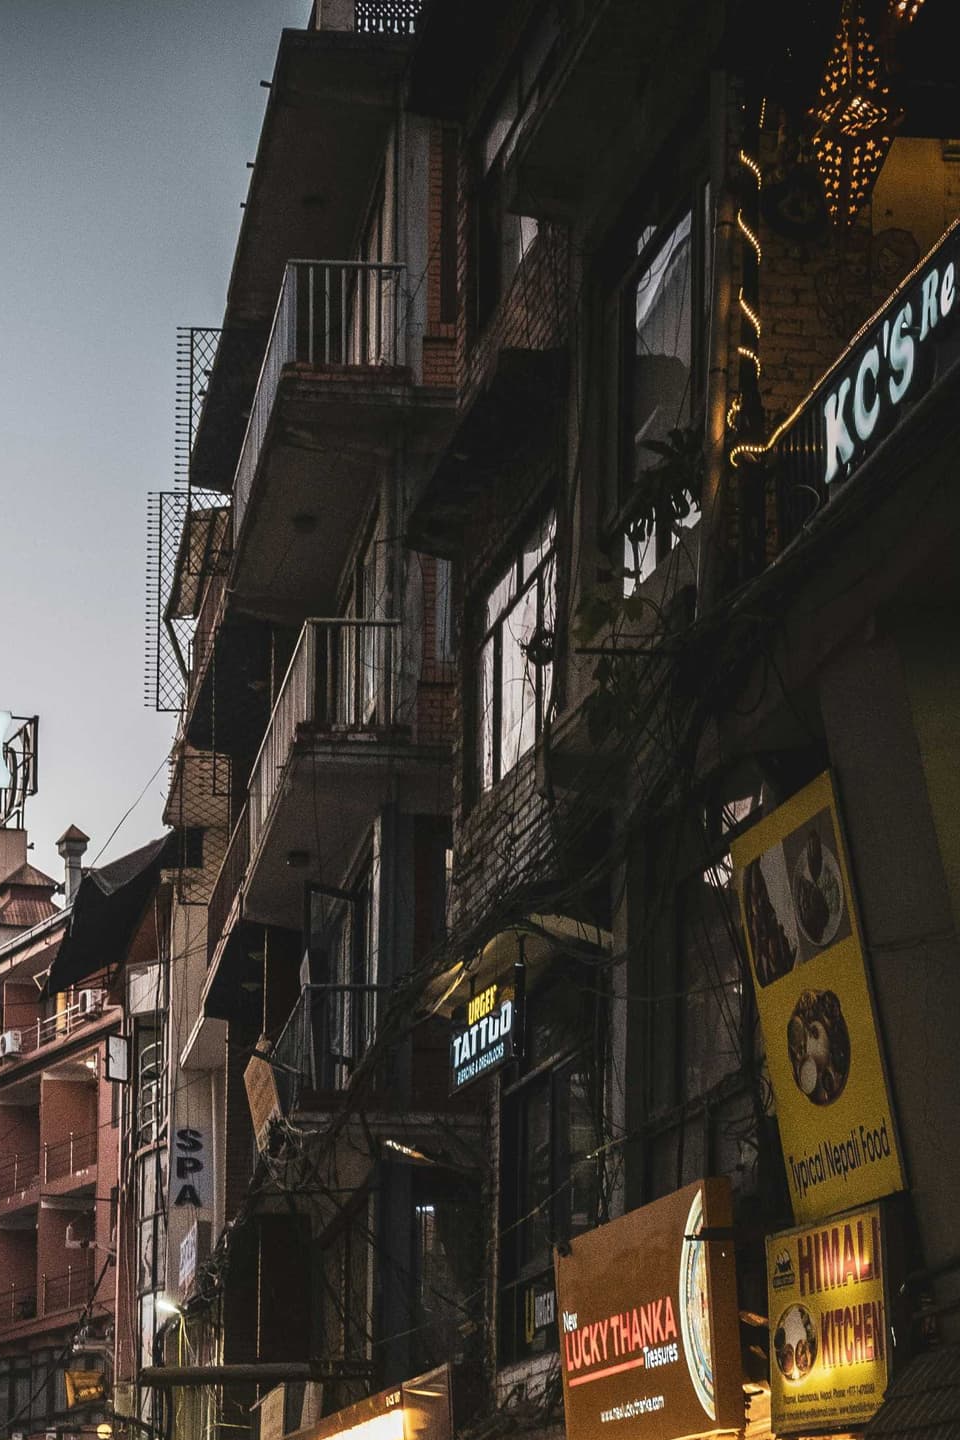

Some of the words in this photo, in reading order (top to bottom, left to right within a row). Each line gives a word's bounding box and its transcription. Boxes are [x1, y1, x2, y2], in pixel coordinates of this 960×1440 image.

[824, 302, 914, 484] KC'S
[174, 1128, 203, 1208] SPA
[789, 1145, 827, 1199] Typical
[824, 1129, 861, 1181] Nepali
[859, 1117, 891, 1164] Food
[798, 1216, 881, 1296] HIMALI
[563, 1311, 578, 1333] New
[565, 1319, 608, 1372] LUCKY
[610, 1296, 677, 1357] THANKA
[643, 1343, 678, 1369] Treasures
[821, 1299, 885, 1369] KITCHEN
